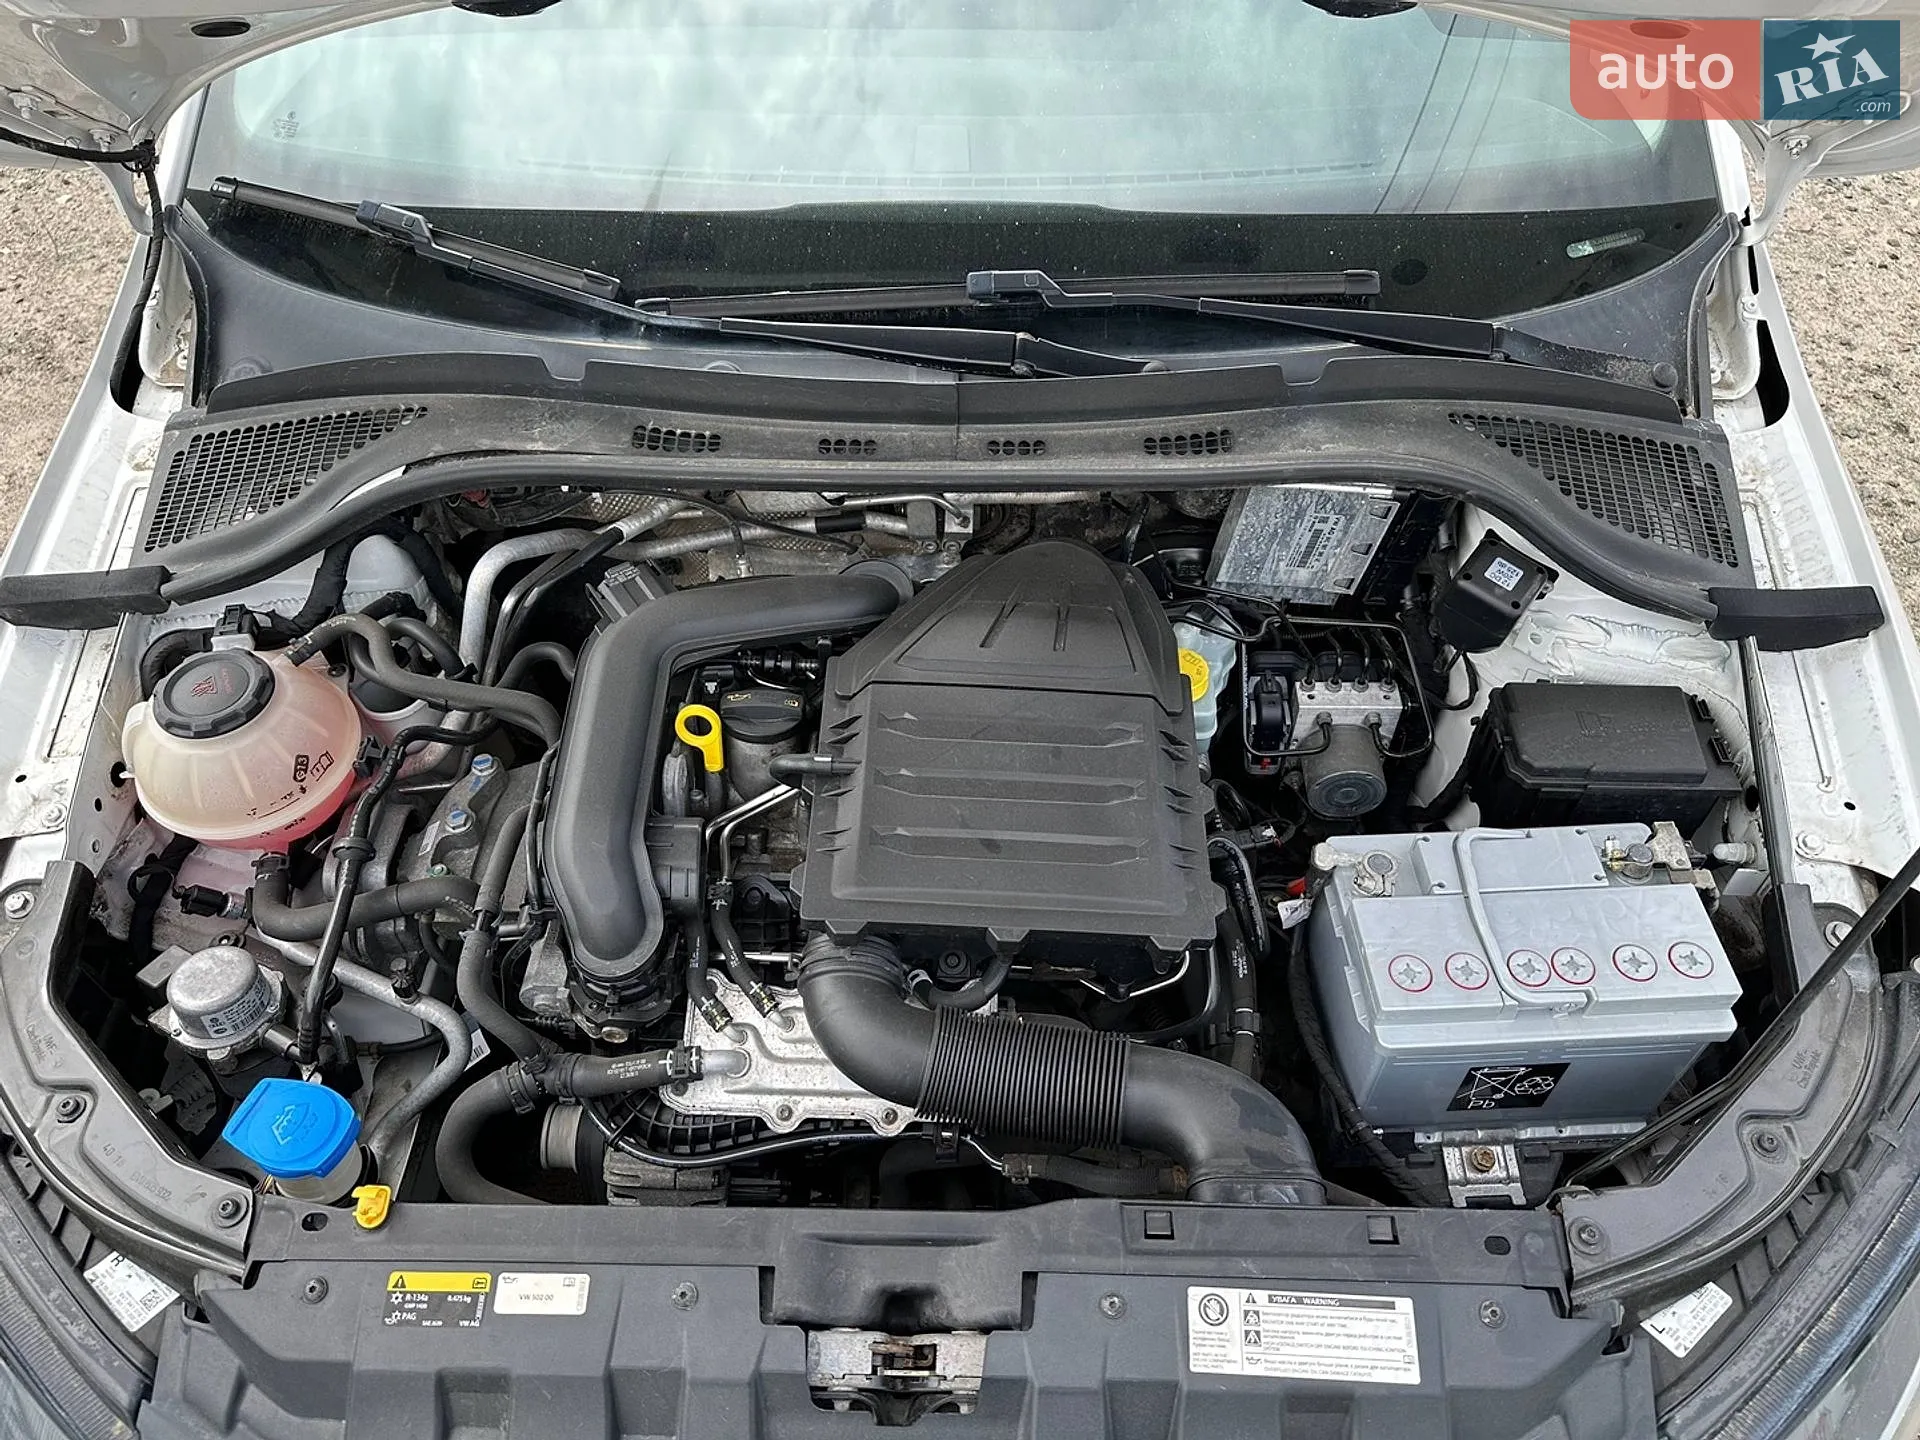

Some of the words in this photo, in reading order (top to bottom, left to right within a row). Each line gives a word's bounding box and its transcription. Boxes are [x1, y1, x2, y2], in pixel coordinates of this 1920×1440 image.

[1467, 1099, 1496, 1109] Pb
[110, 1254, 125, 1267] R
[1302, 1297, 1340, 1307] WARNING
[401, 1312, 416, 1320] PAG
[1650, 1323, 1666, 1335] L
